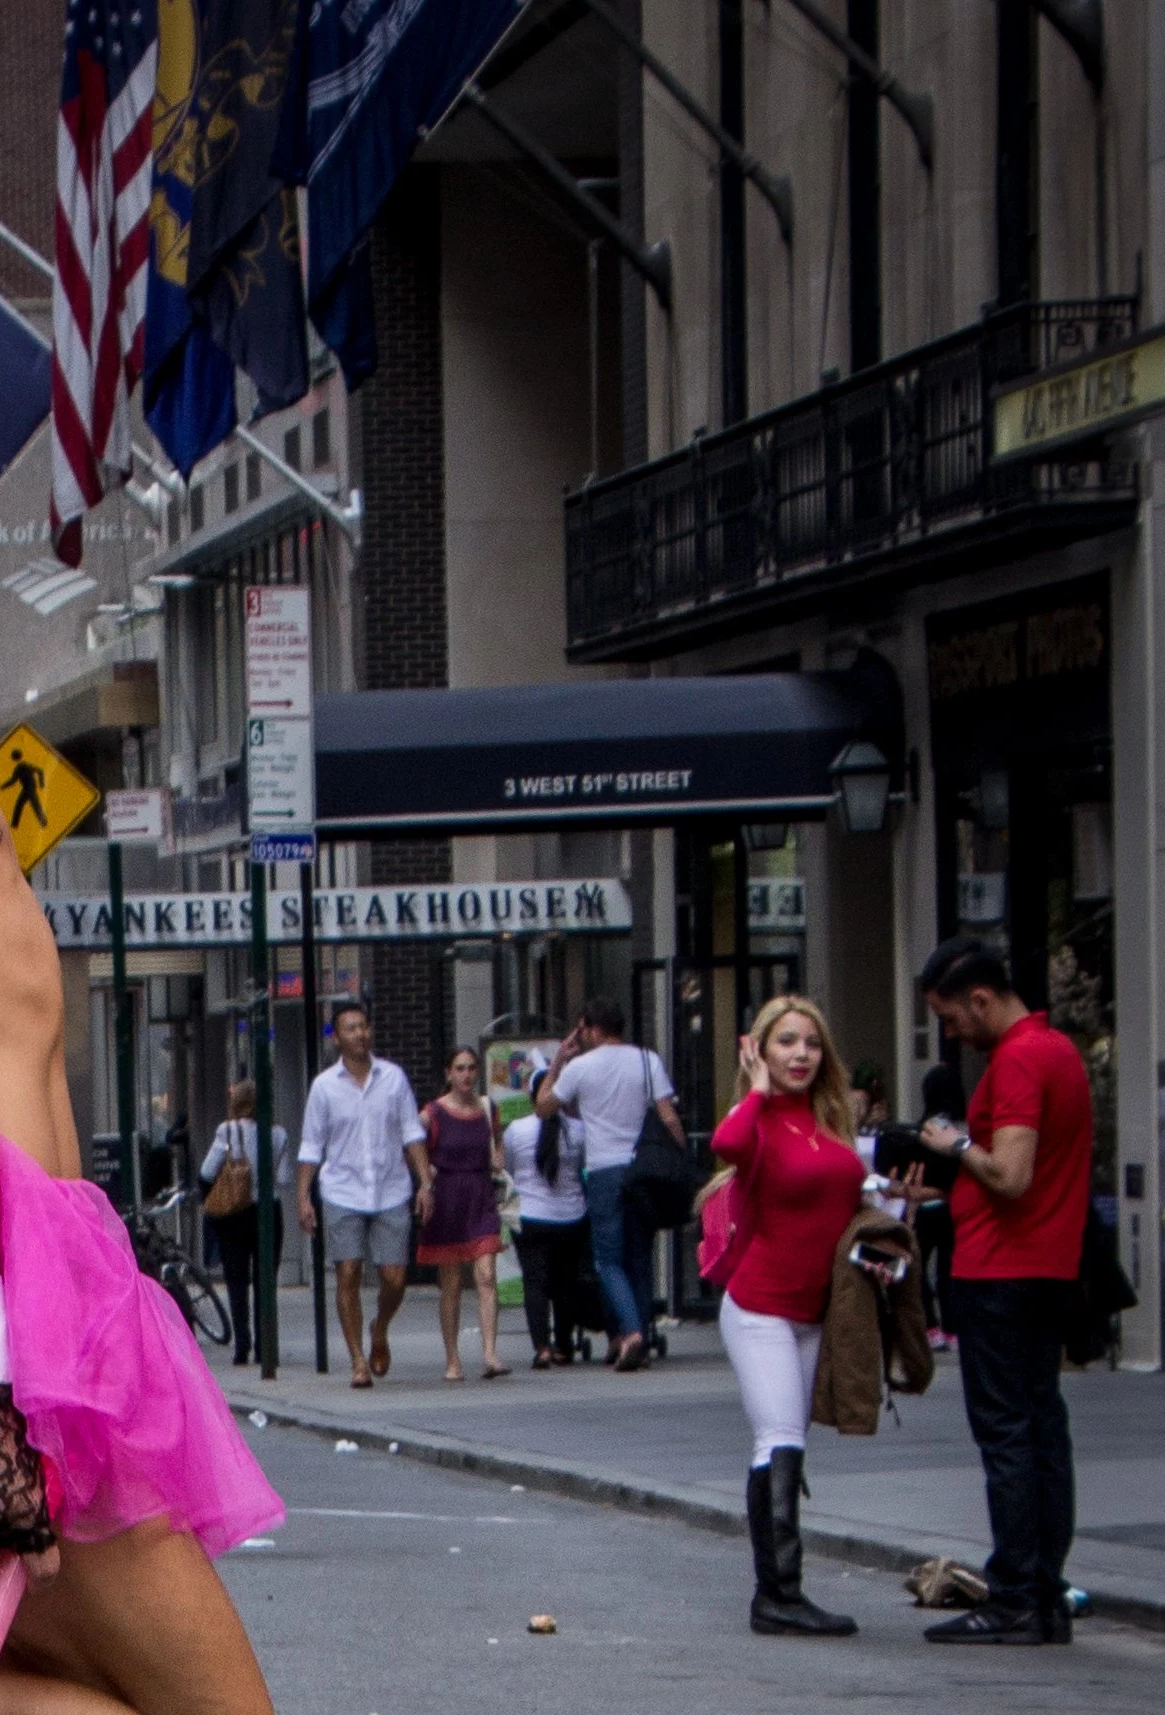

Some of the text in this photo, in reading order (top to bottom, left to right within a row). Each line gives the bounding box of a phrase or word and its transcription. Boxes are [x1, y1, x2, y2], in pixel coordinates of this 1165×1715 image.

[13, 520, 35, 543] of
[251, 721, 262, 745] 6
[504, 777, 516, 797] 3
[521, 775, 577, 796] WEST
[616, 770, 693, 792] STREET
[67, 899, 253, 936] YANKEES
[281, 886, 567, 930] STEAKHOUSE
